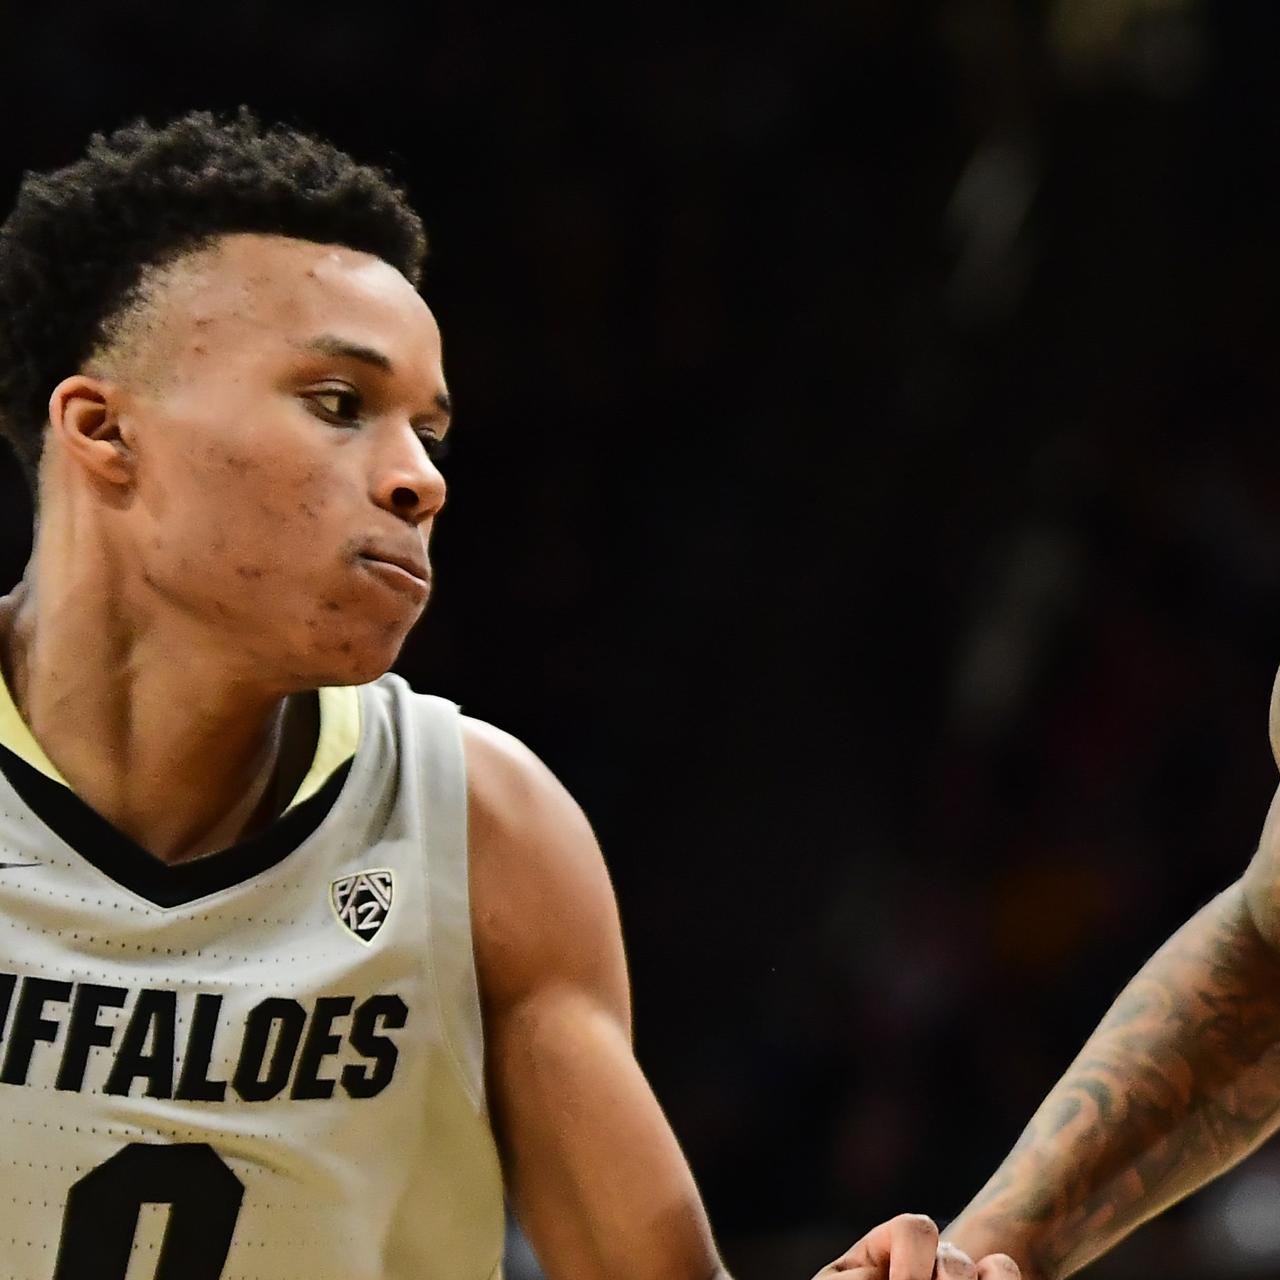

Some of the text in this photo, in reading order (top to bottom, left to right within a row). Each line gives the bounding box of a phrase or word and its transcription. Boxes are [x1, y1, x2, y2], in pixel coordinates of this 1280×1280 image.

[332, 872, 391, 919] PAC
[349, 901, 381, 930] 12
[0, 972, 409, 1104] FFALOES
